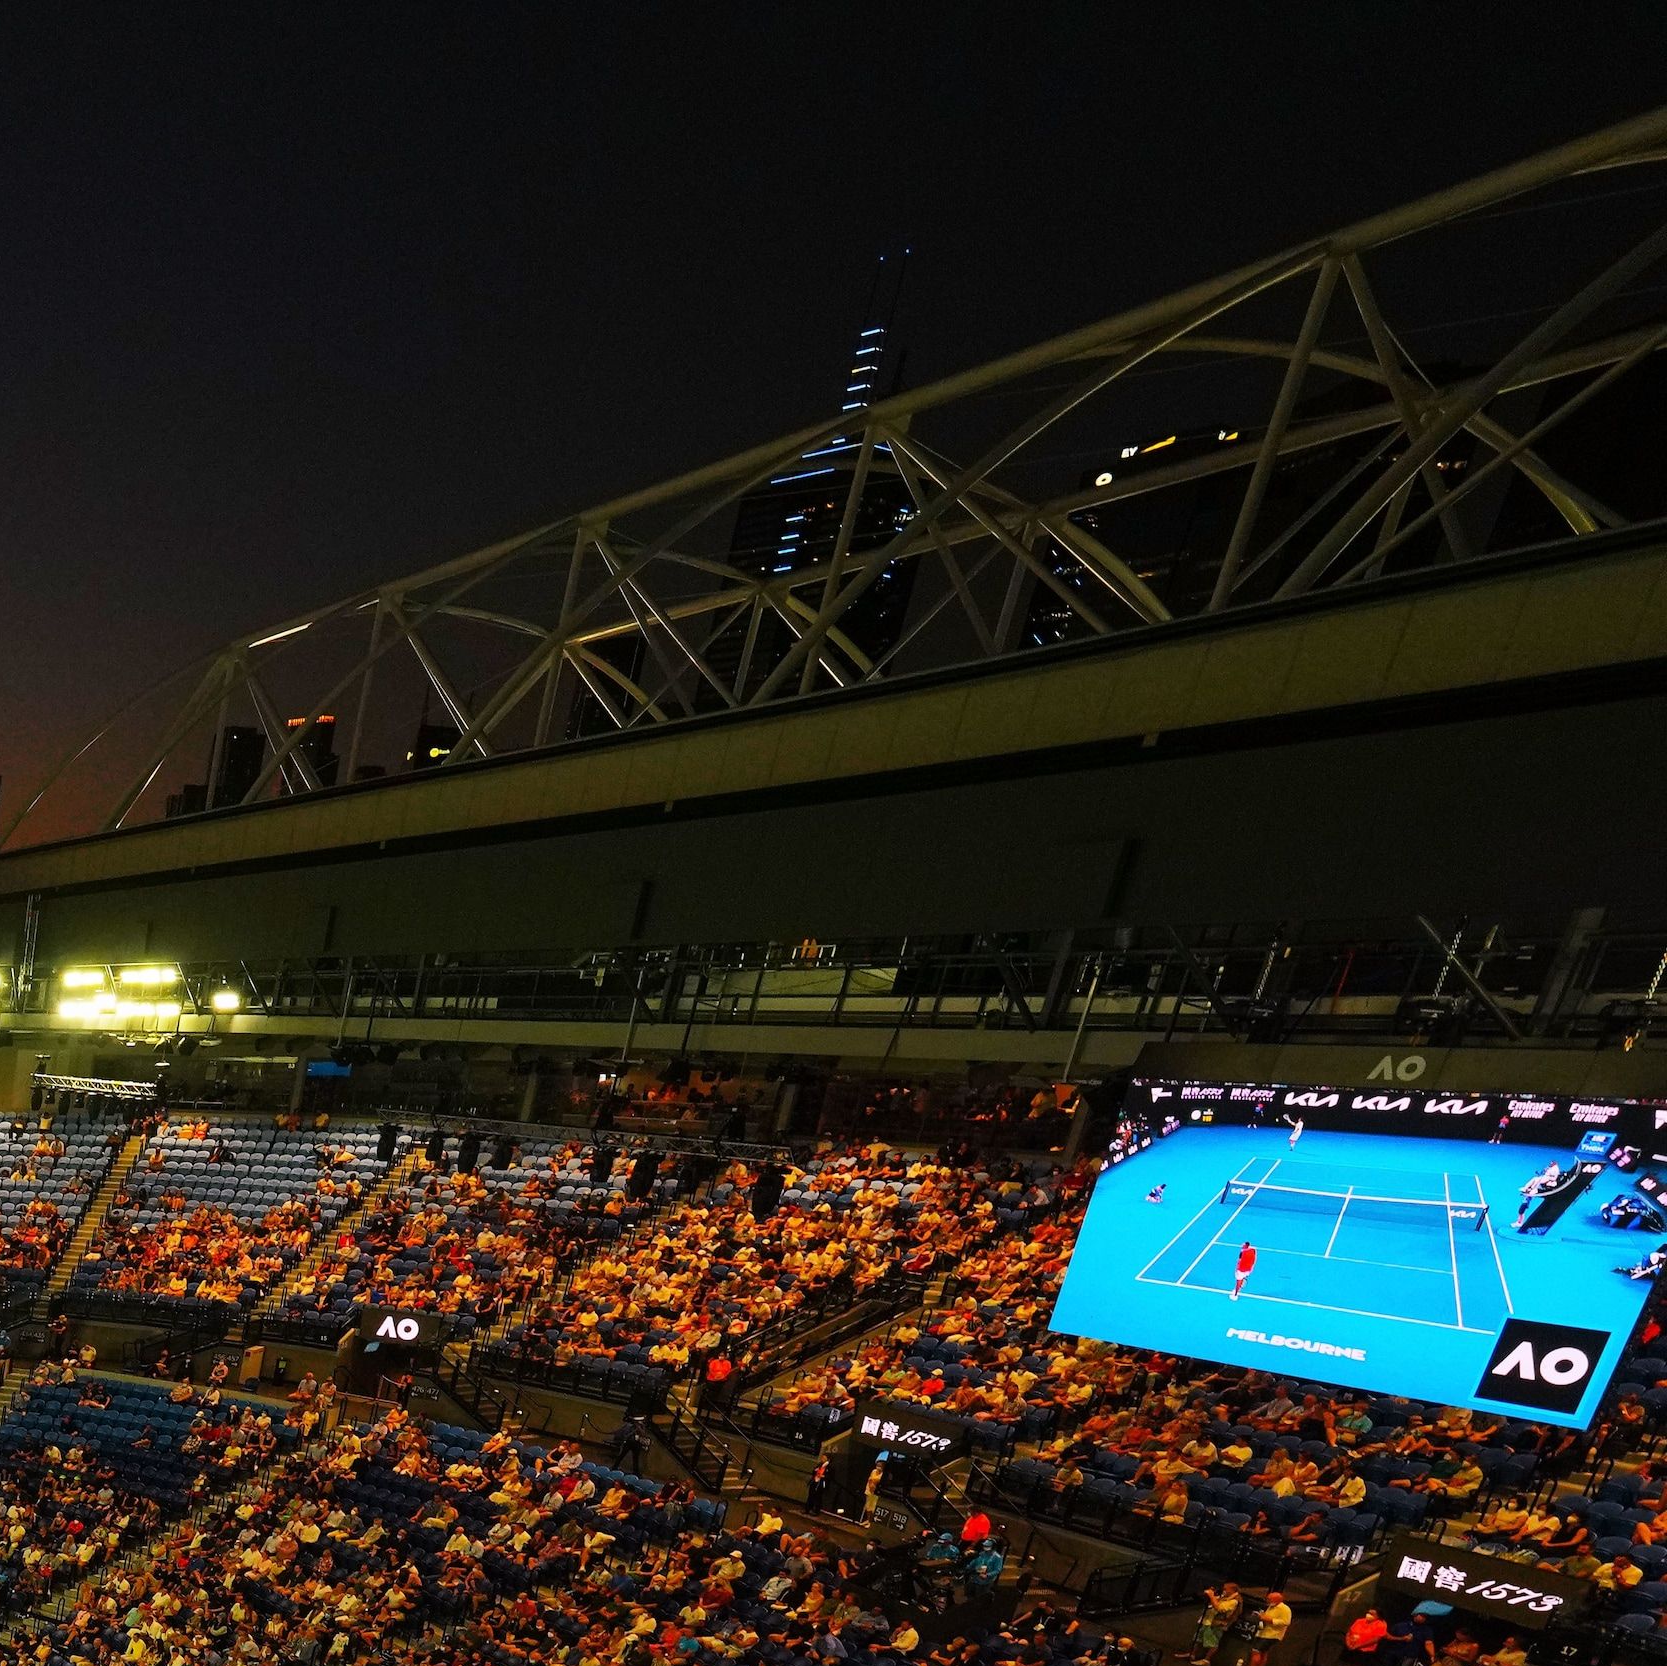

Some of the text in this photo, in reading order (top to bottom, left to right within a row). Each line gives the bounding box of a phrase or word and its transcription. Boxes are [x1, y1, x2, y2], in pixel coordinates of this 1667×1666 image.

[1366, 1055, 1427, 1081] AO
[1507, 1100, 1555, 1113] Emirates
[1569, 1103, 1620, 1117] Emirates
[376, 1316, 419, 1340] AO
[1225, 1328, 1366, 1362] MELBOURNE
[1491, 1341, 1589, 1386] AO
[875, 1506, 907, 1523] 517 518
